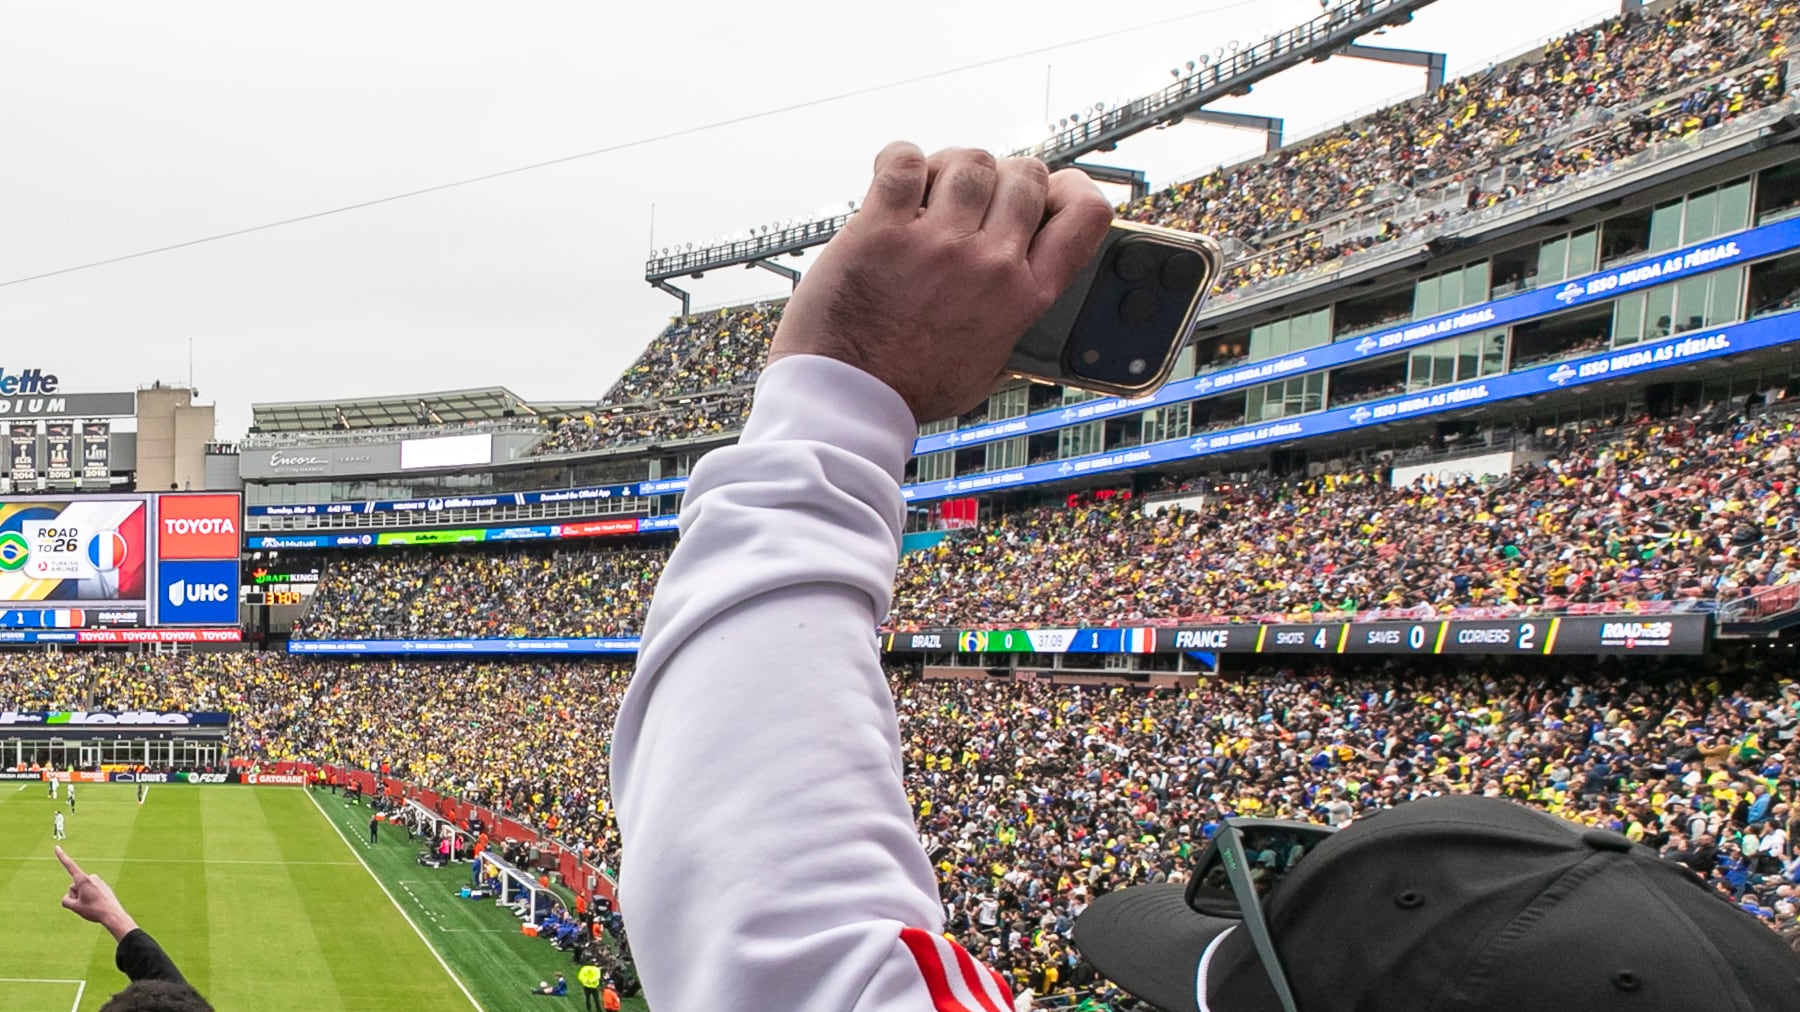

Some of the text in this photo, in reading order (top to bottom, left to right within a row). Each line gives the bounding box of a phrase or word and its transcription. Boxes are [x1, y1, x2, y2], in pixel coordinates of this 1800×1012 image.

[1586, 243, 1740, 294] ISSO MUDA AS FÉRIAS.
[1379, 333, 1402, 347] ISSO
[1404, 324, 1435, 340] MUDA
[1437, 319, 1451, 332] AS
[1579, 335, 1730, 376] ISSO MUDA AS FÉRIAS.
[1373, 404, 1396, 417] ISSO
[1398, 398, 1428, 412] MUDA
[1430, 394, 1445, 406] AS
[269, 450, 329, 467] Encore
[12, 471, 34, 480] 2014
[38, 528, 78, 537] ROAD
[164, 518, 235, 534] TOYOTA
[187, 583, 228, 602] UHC
[265, 592, 301, 605] 37:09
[17, 613, 24, 624] 1
[122, 632, 158, 640] TOYOTA
[160, 632, 196, 640] TOYOTA
[202, 632, 238, 640] TOYOTA
[911, 635, 942, 648] BRAZIL
[1004, 632, 1014, 649] 0
[1037, 635, 1064, 647] 37:09
[1091, 632, 1099, 649] 1
[1176, 630, 1228, 648] FRANCE
[1276, 628, 1327, 649] SHOTS 4
[1368, 625, 1425, 649] SAVES 0
[1458, 624, 1536, 649] CORNERS 2
[136, 773, 168, 782] LOWE'S
[259, 774, 302, 784] GATORADE
